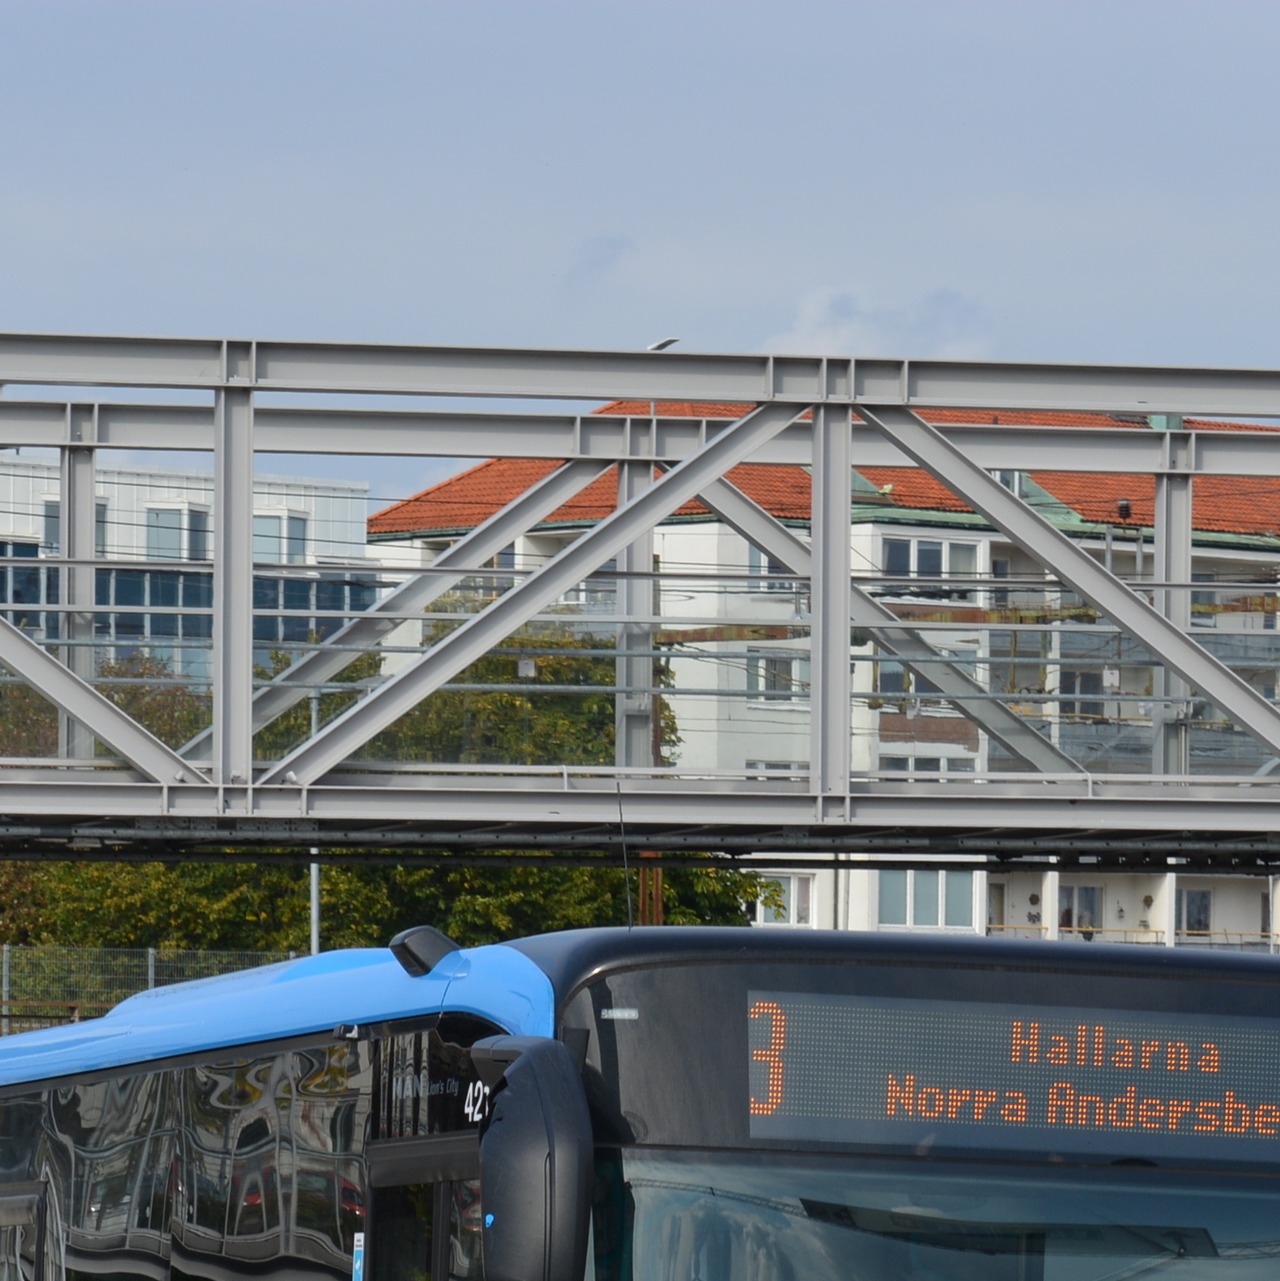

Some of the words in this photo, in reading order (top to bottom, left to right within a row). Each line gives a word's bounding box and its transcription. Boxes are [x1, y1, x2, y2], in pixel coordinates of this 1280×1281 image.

[750, 1001, 786, 1115] 3
[1011, 1020, 1220, 1073] Hallarna
[886, 1073, 1027, 1122] Norra
